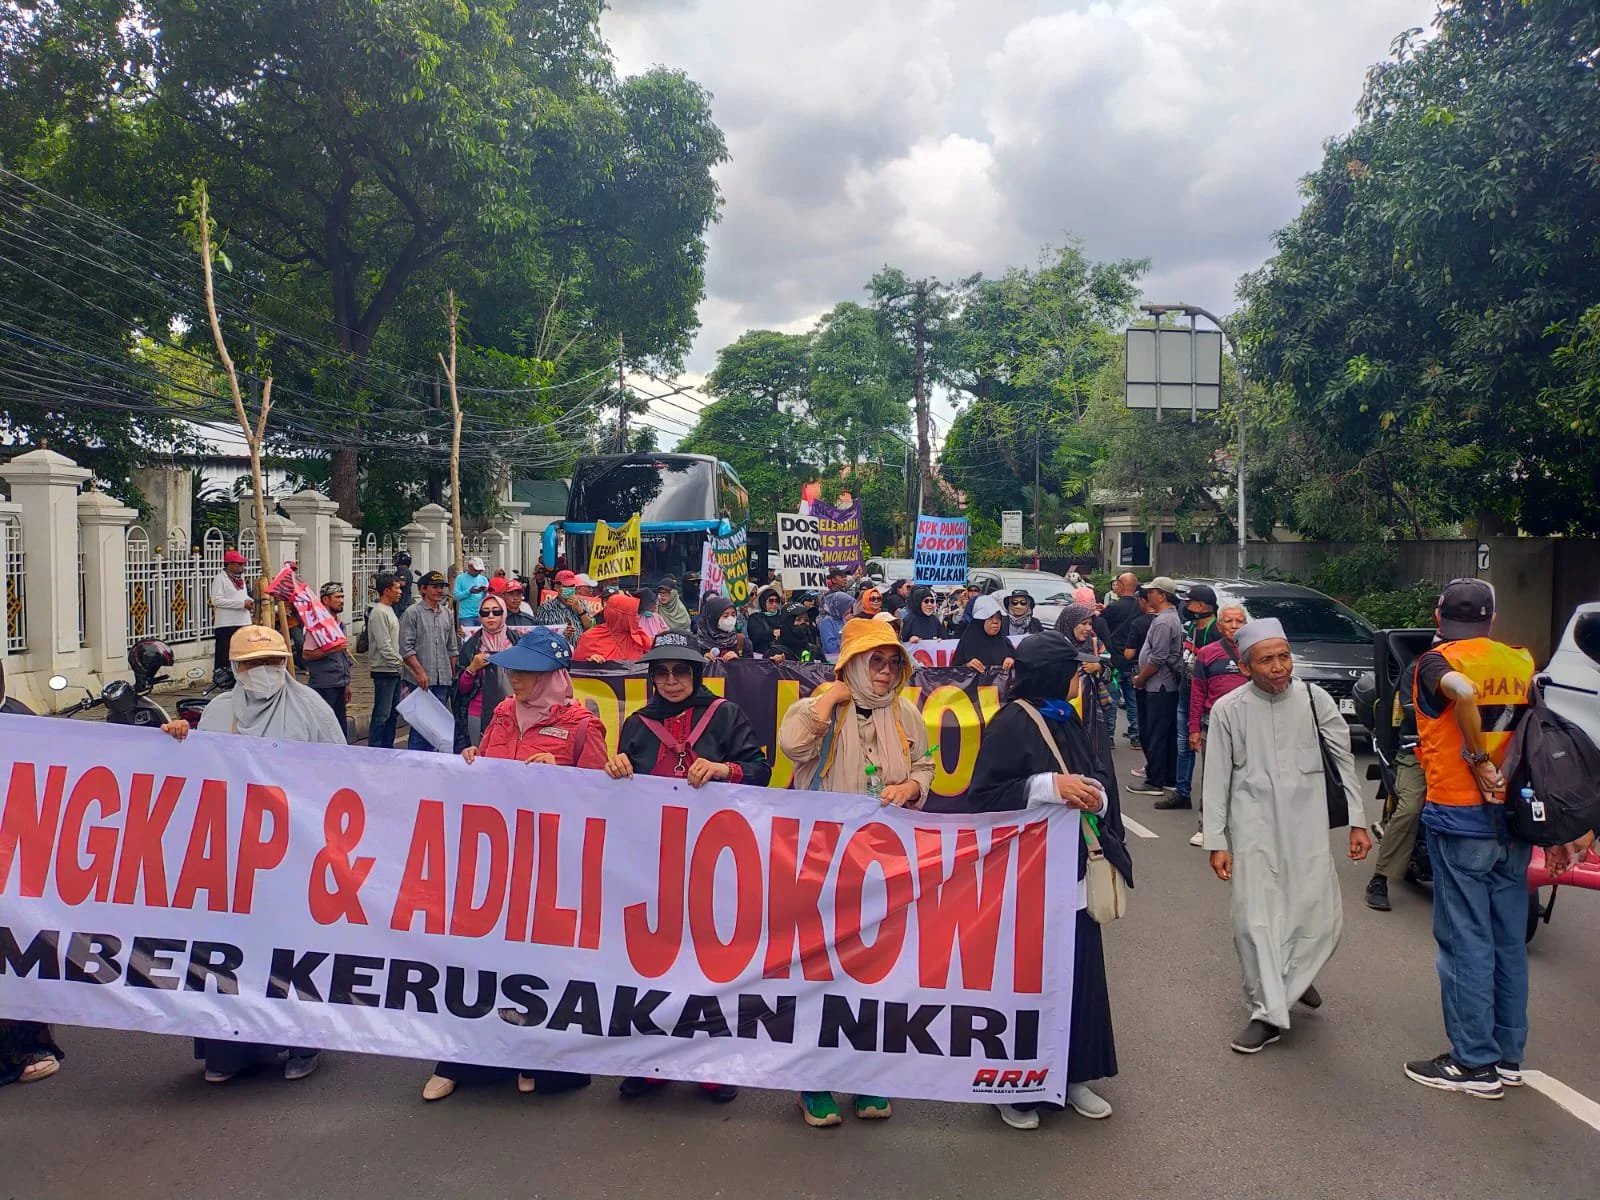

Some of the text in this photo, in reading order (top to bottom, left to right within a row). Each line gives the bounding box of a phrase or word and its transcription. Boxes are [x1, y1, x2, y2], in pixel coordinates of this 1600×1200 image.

[918, 520, 936, 535] KPK
[782, 536, 822, 552] JOKO
[820, 534, 859, 547] ISTEM
[917, 537, 966, 551] JOKOWI
[822, 549, 858, 563] EMOKRASI
[940, 553, 966, 566] RAKYAT
[1478, 551, 1489, 567] 7
[597, 557, 635, 577] RAKYAT
[916, 567, 965, 582] NEPALKAN
[800, 572, 828, 587] IKN
[1472, 677, 1526, 699] AHAN
[0, 762, 1048, 994] NGKAP & ADILI JOKOWI
[0, 926, 1039, 1060] MBER KERUSAKAN NKRI
[972, 1068, 1049, 1088] ARM
